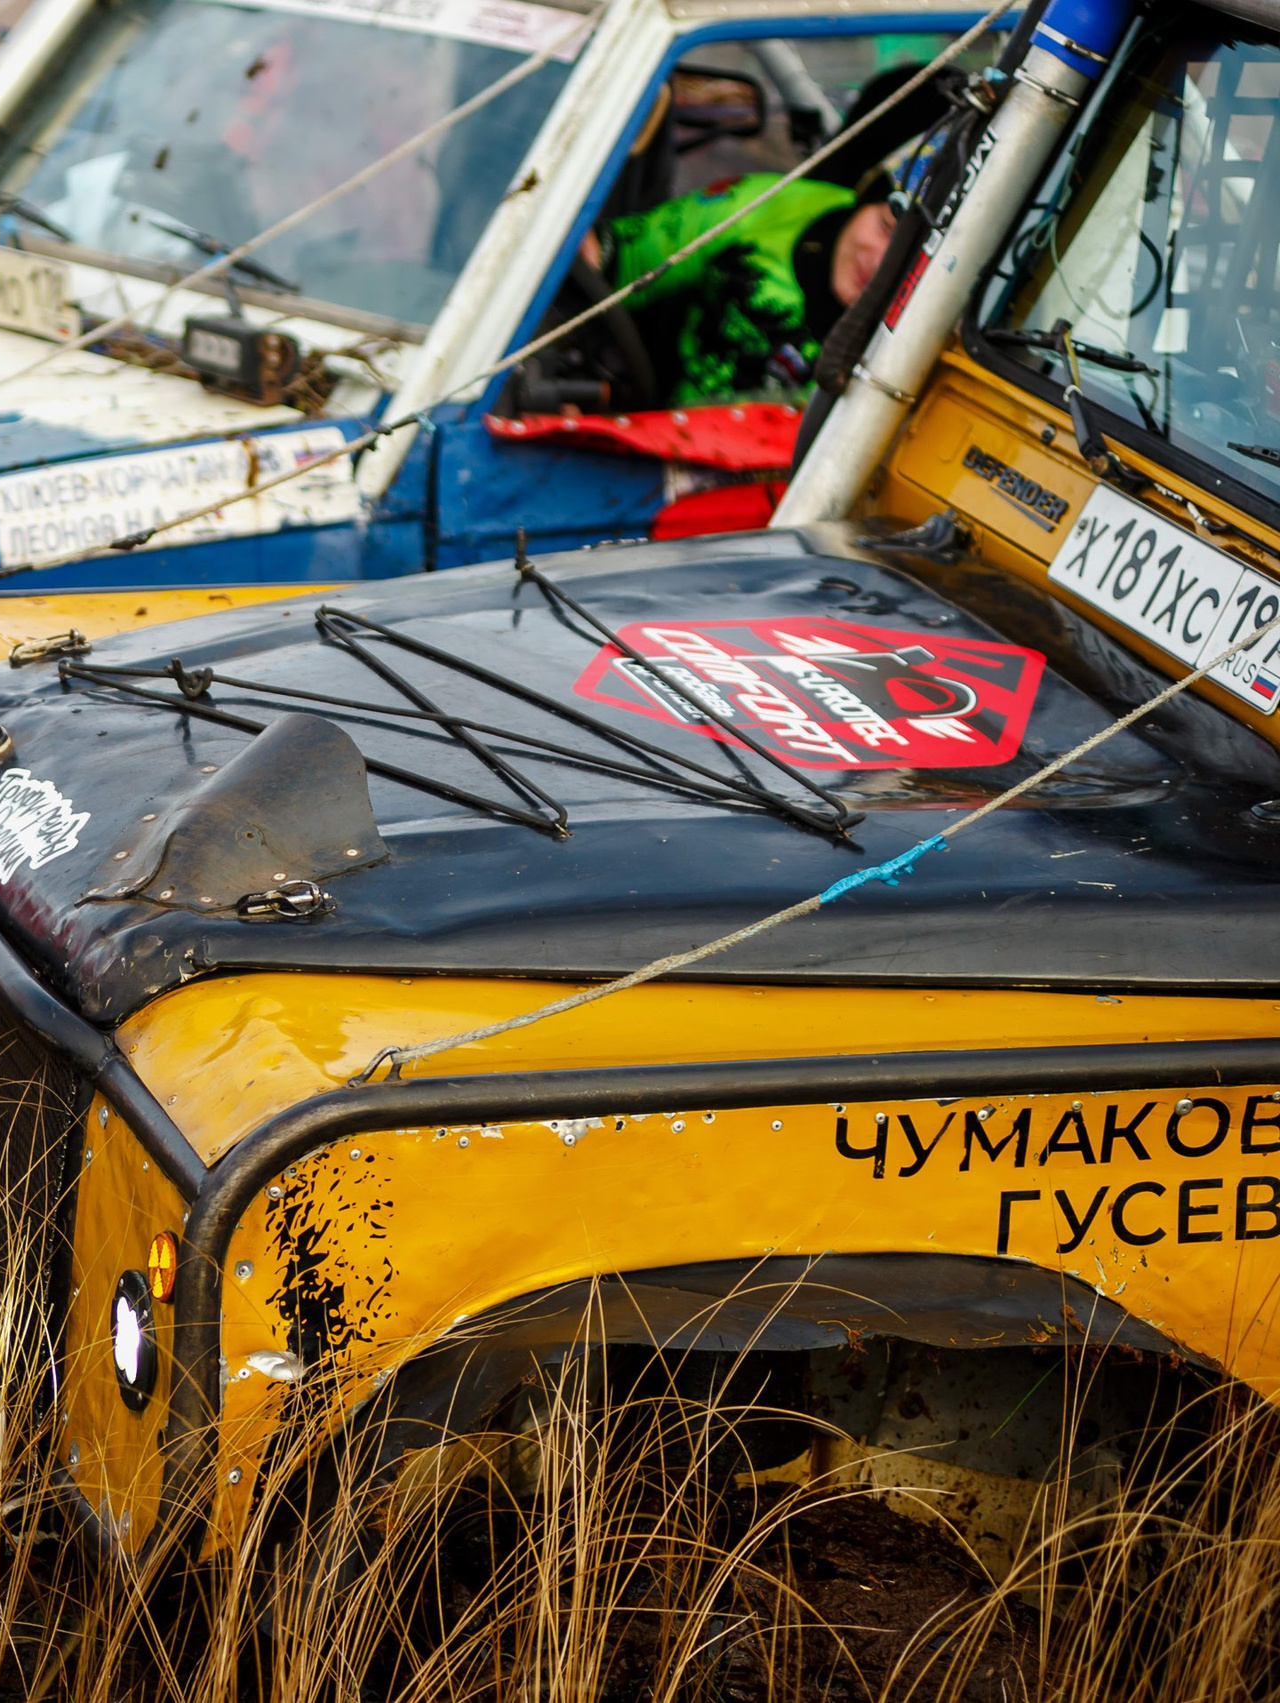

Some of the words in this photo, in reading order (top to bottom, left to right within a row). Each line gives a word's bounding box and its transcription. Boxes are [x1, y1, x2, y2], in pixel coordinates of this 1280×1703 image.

[962, 444, 1070, 525] DEFENDER
[9, 512, 117, 558] ЛЕОНОВ
[1228, 585, 1280, 666] 19
[642, 626, 861, 764] COMFORT
[1219, 652, 1258, 685] RUS
[835, 1097, 1280, 1179] ЧУМАКОВ
[996, 1175, 1280, 1256] ГУСЕВ
